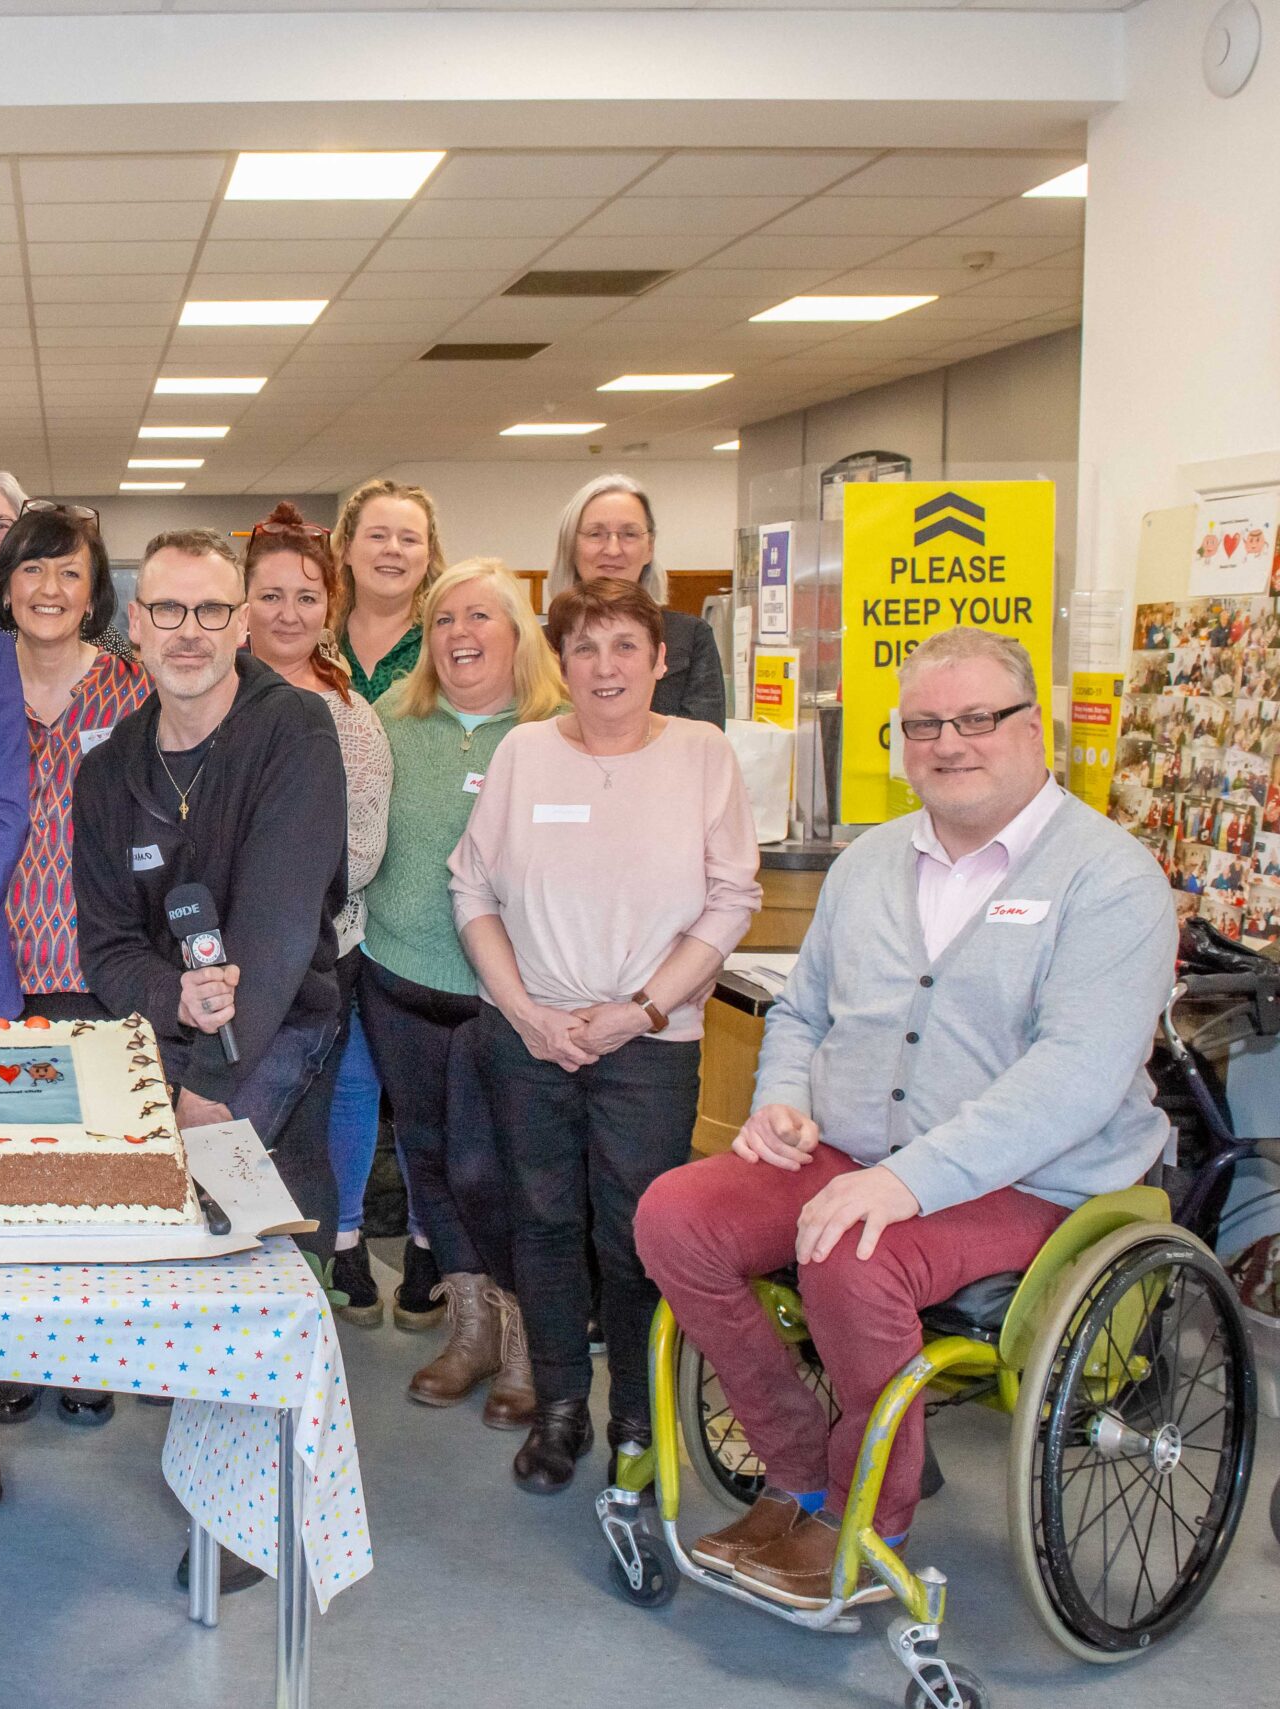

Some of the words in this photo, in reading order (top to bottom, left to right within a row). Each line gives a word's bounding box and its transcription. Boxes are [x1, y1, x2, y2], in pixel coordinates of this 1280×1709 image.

[890, 555, 1006, 584] PLEASE
[863, 598, 941, 626] KEEP
[949, 596, 1033, 625] YOUR
[168, 903, 200, 920] RØDE
